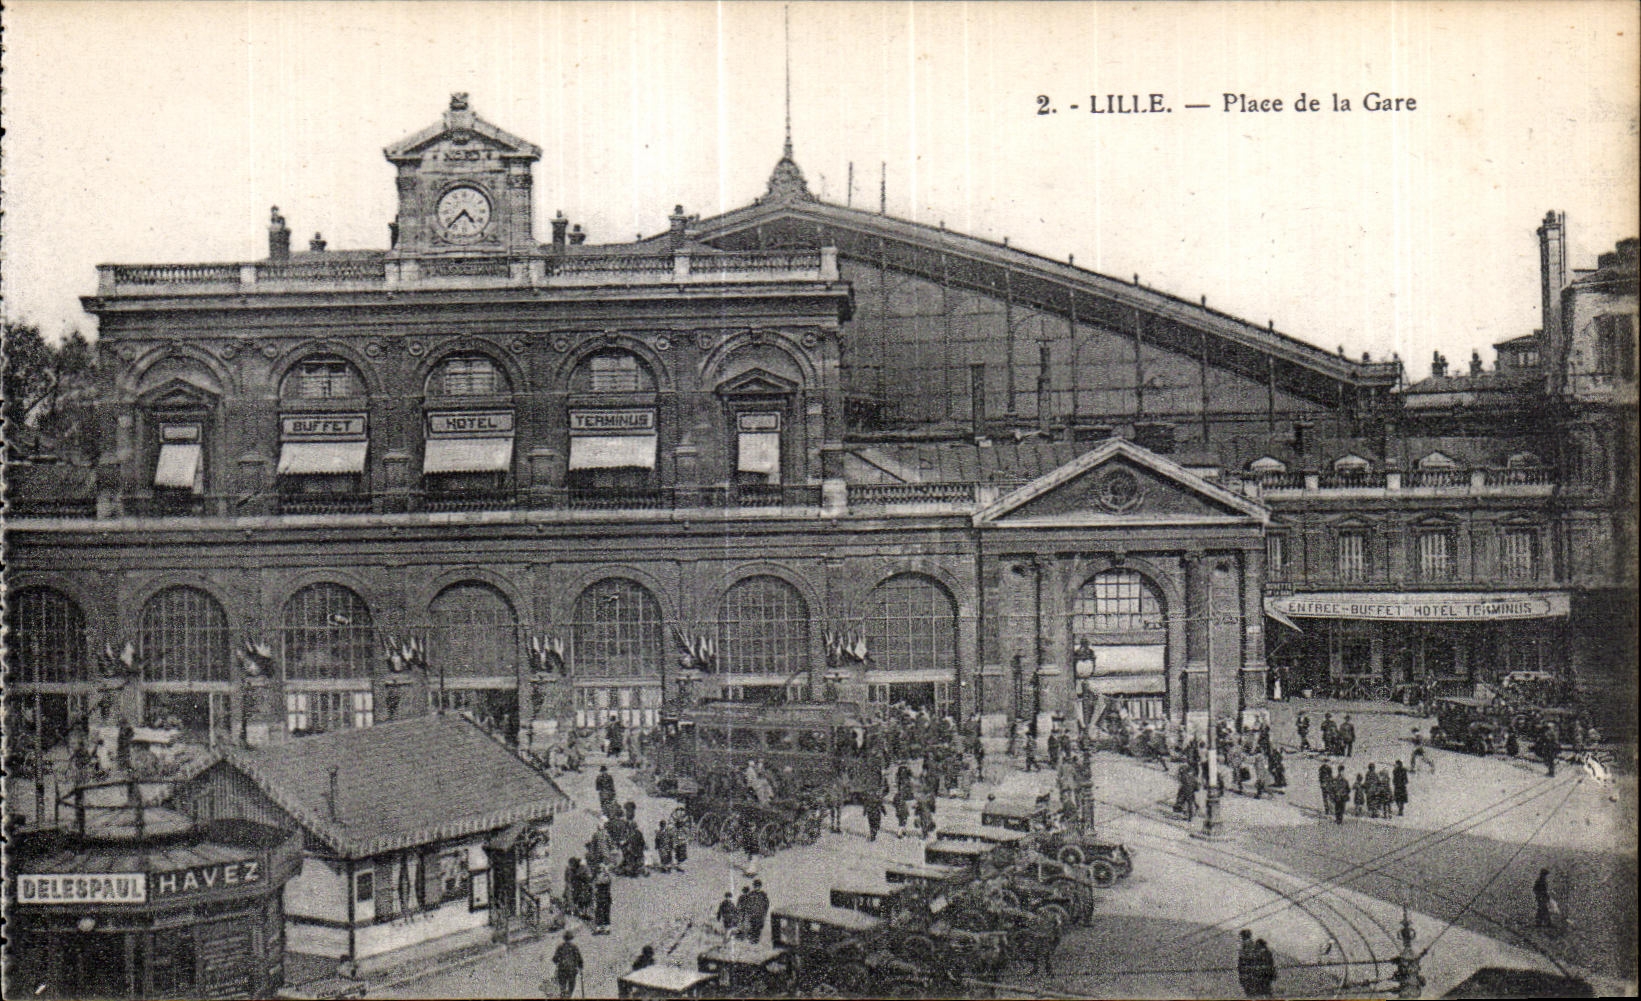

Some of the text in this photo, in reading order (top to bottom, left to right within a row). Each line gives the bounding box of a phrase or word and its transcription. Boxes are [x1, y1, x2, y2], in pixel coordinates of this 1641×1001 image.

[292, 420, 353, 432] BUFFET
[446, 417, 497, 430] HOTEL
[575, 414, 649, 427] TERMINUS
[1414, 605, 1457, 617] HOTEL
[1464, 602, 1532, 617] TERMINUS
[159, 861, 259, 894] HAVEZ
[23, 878, 143, 900] DELESPAUL
